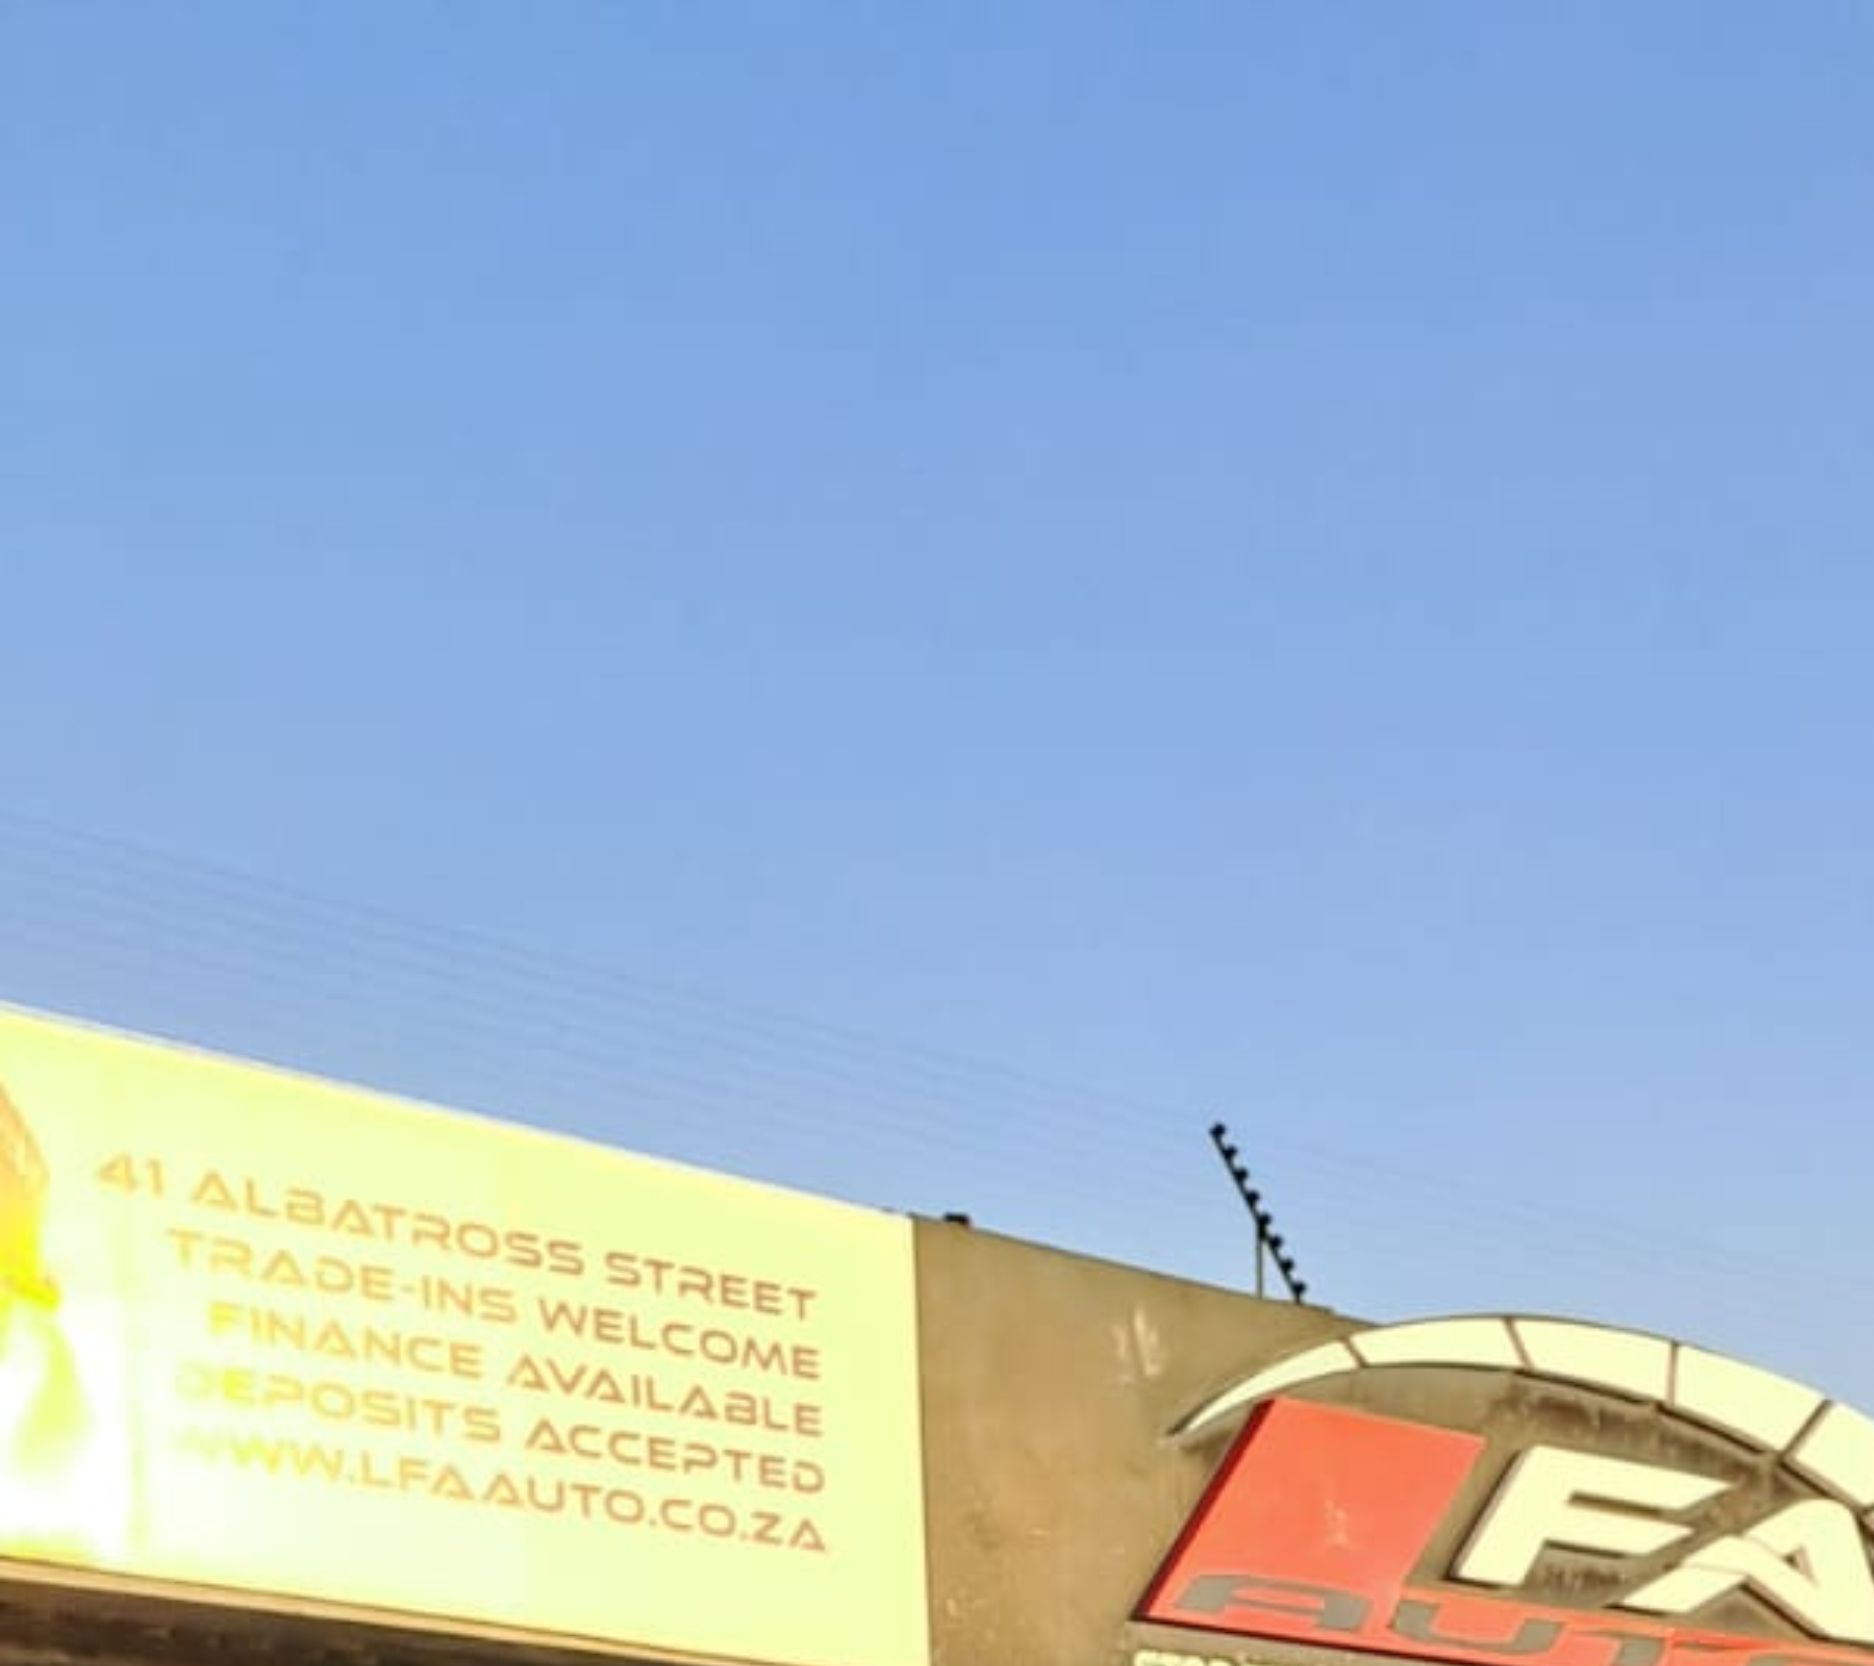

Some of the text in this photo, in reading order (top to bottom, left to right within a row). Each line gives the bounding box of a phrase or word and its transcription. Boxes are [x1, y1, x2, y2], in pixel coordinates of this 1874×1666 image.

[94, 1151, 818, 1322] 41 ALBATROSS STREET
[166, 1228, 821, 1380] TRADE-INS WELCOME
[174, 1358, 827, 1496] DEPOSITS ACCEPTED
[208, 1299, 824, 1438] FINANCE AVAILABLE
